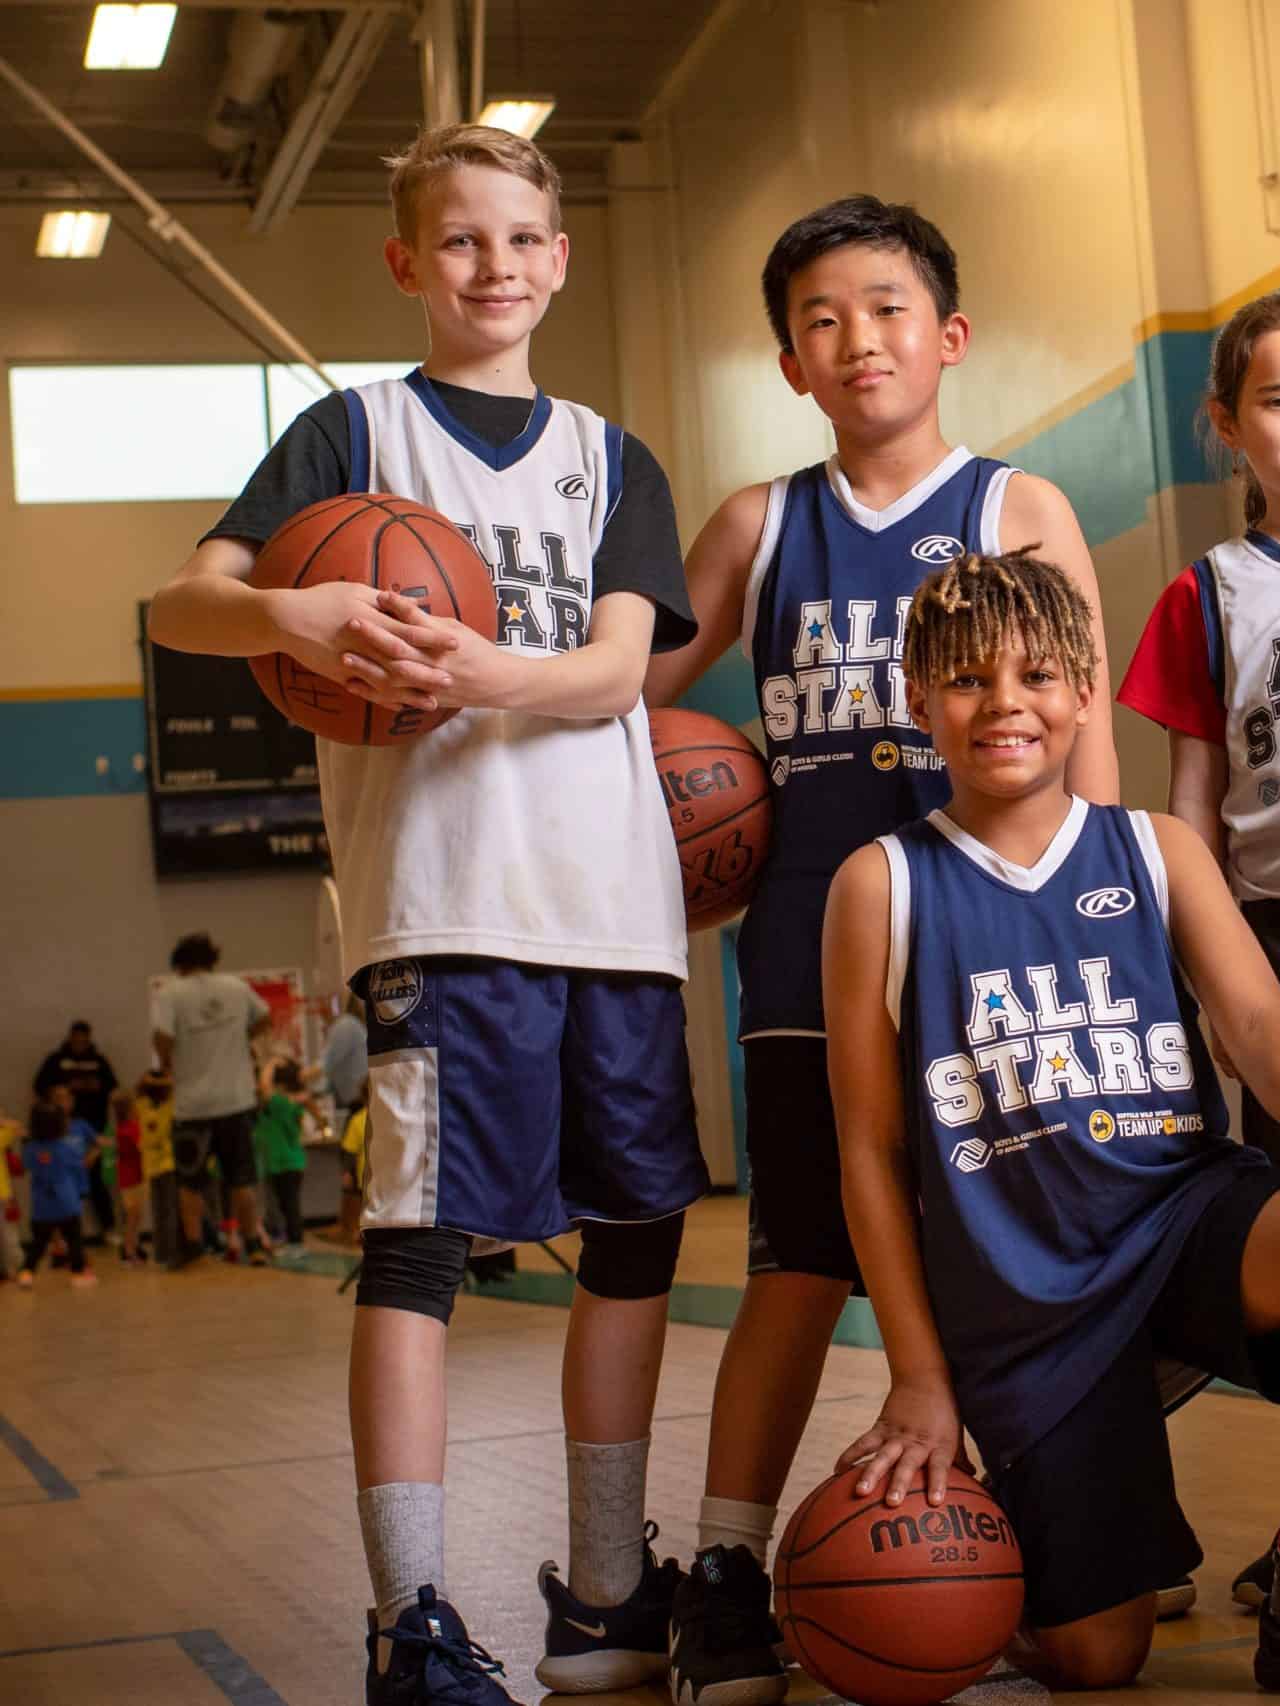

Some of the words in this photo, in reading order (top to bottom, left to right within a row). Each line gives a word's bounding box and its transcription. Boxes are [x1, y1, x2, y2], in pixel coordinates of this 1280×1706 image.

[902, 753, 928, 770] TEAM
[966, 956, 1139, 1046] ALL
[925, 1022, 1195, 1128] STARS
[1117, 1120, 1148, 1137] TEAM
[1148, 1120, 1164, 1136] UP
[1177, 1115, 1204, 1133] KIDS
[869, 1503, 1018, 1553] molten
[930, 1546, 979, 1563] 28.5
